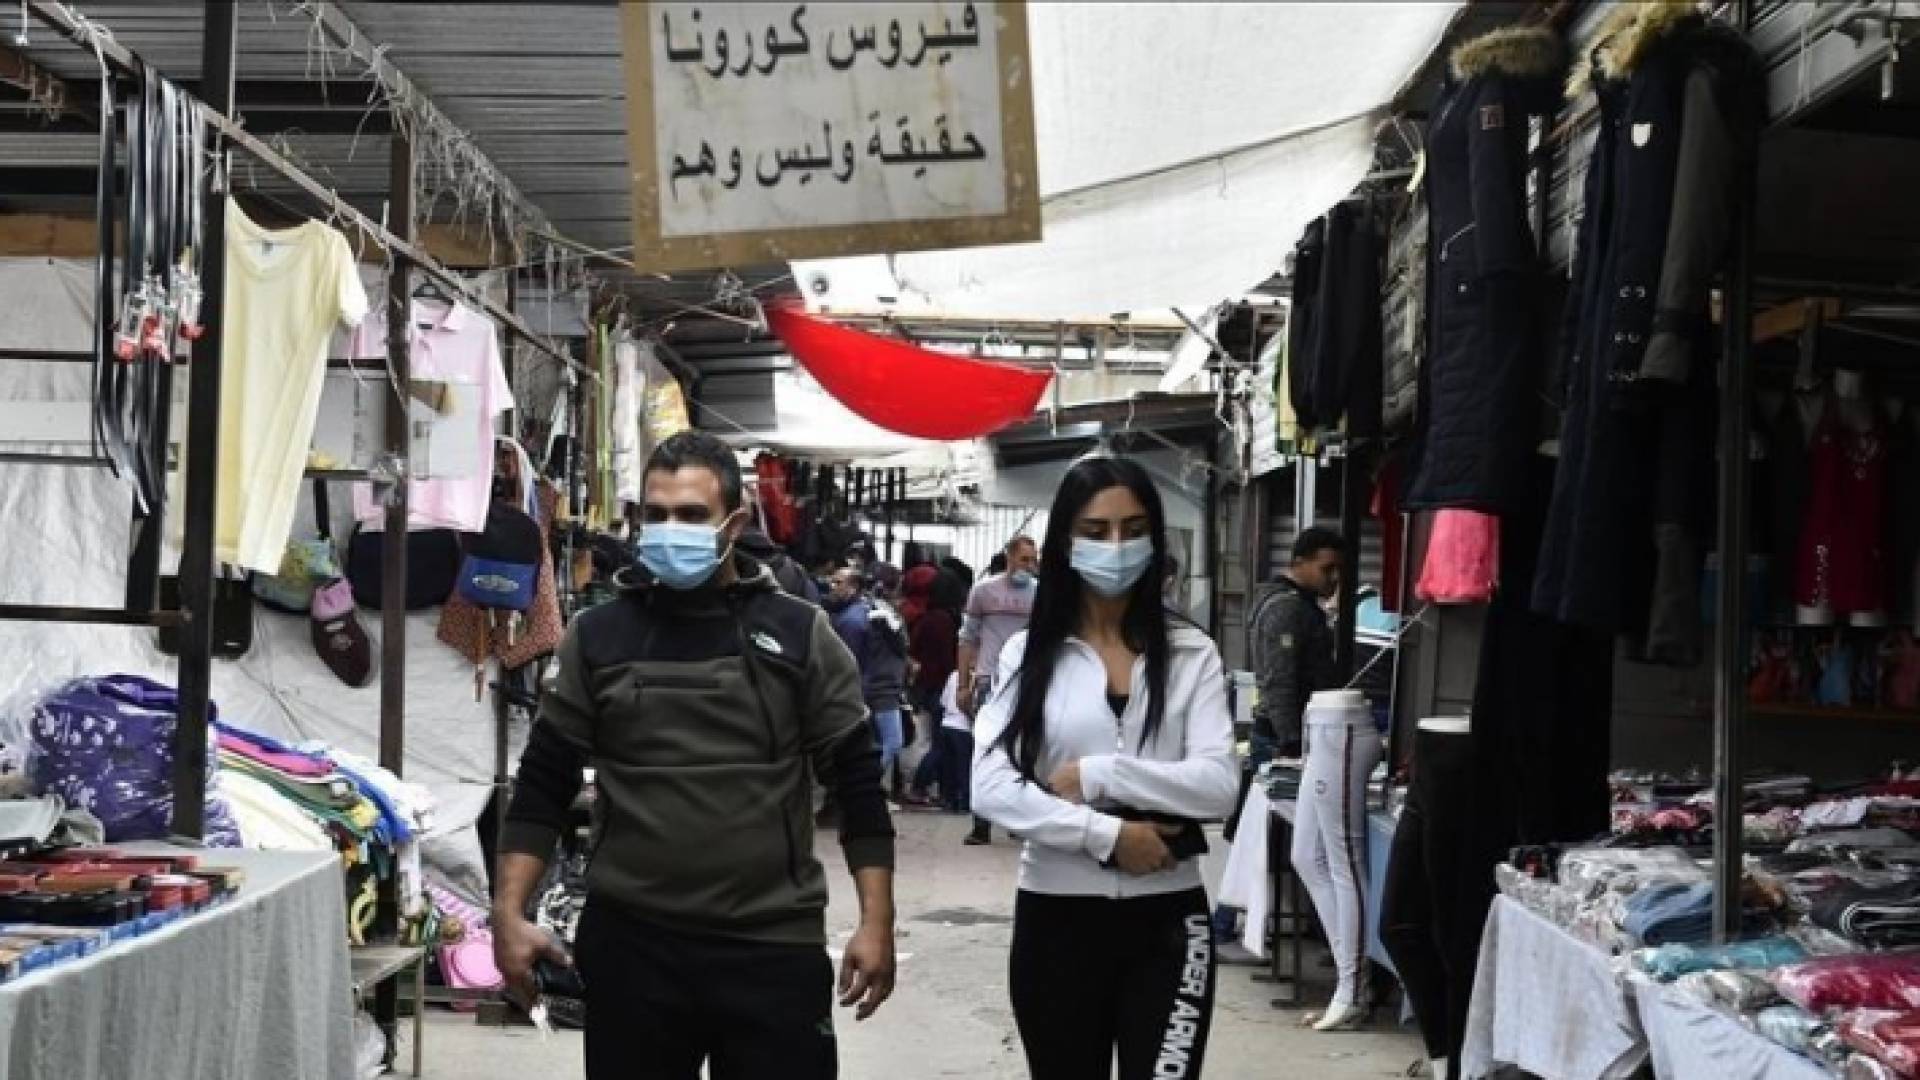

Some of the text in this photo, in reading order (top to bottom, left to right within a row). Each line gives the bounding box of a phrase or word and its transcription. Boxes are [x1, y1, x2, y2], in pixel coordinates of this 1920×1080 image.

[662, 2, 979, 79] فيروس كورونا
[670, 110, 986, 203] حقيقة وليس وهم
[1153, 914, 1210, 1080] UNDER ARMO
